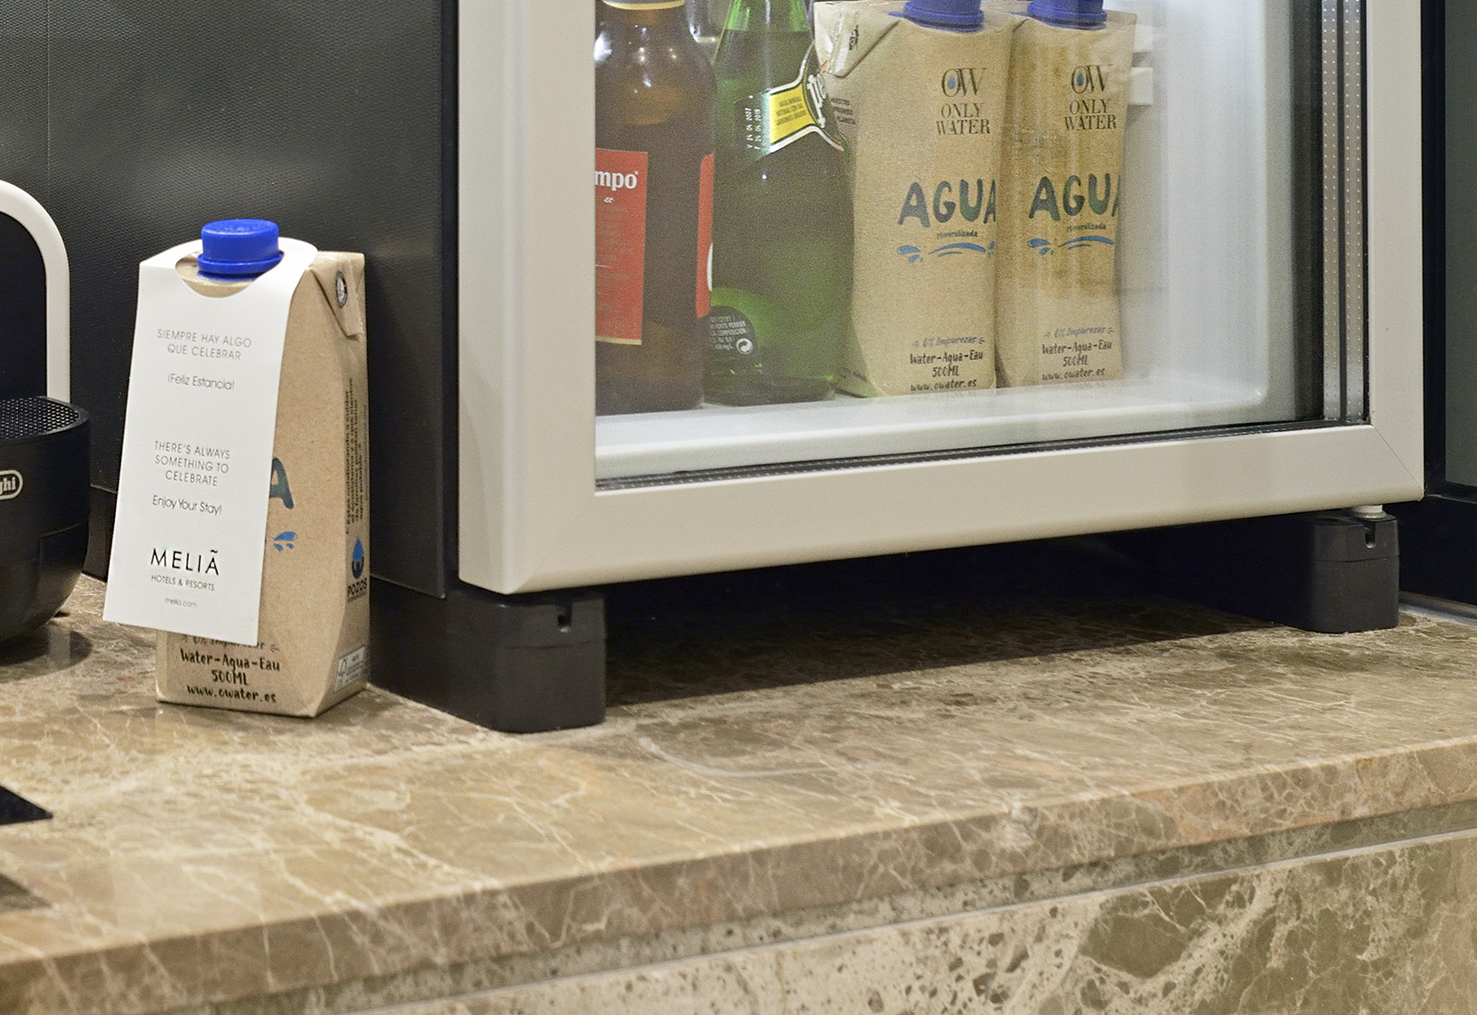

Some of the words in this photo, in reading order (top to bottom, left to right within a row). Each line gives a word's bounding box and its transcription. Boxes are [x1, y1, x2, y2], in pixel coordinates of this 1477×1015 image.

[941, 68, 986, 97] OW
[1071, 64, 1113, 94] OW
[941, 103, 984, 118] ONLY
[1069, 98, 1111, 115] ONLY
[936, 118, 990, 135] WATER
[1064, 114, 1117, 131] WATER
[898, 179, 996, 228] AGUA
[157, 328, 197, 343] SIEMPRE
[201, 333, 220, 344] HAY
[222, 335, 252, 348] ALGO
[167, 344, 187, 357] QUE
[191, 346, 242, 360] CELEBRAR
[192, 376, 235, 391] Estancia!
[194, 446, 230, 460] ALWAYS
[154, 455, 214, 472] SOMETHING
[216, 462, 229, 474] TO
[165, 470, 218, 486] CELEBRATE
[152, 495, 176, 509] Enjoy
[178, 498, 197, 512] Your
[199, 501, 222, 516] Stay!
[151, 574, 176, 586] HOTELS
[178, 578, 183, 586] &
[186, 579, 215, 592] RESORTS
[212, 670, 249, 685] 500ML
